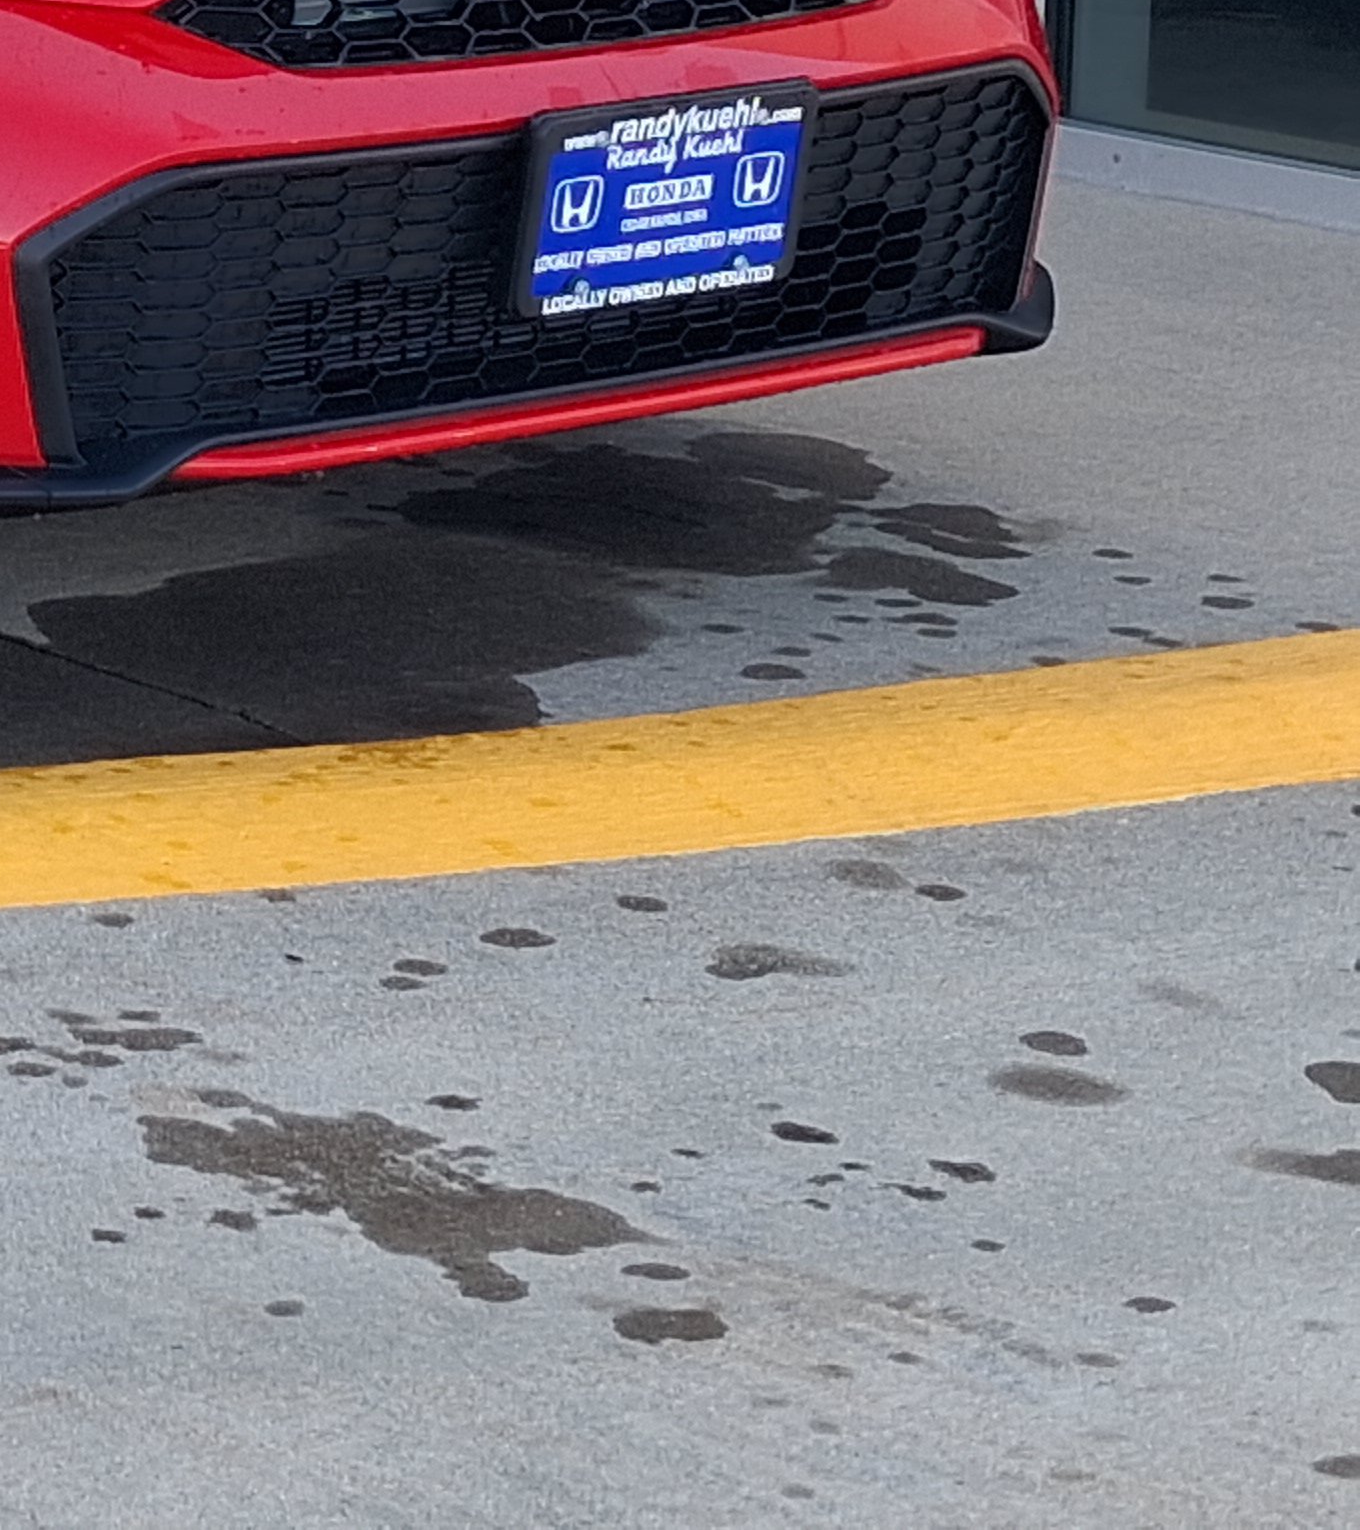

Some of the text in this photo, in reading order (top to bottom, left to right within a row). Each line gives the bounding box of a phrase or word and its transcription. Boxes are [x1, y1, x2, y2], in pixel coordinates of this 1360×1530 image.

[606, 130, 745, 174] Randy Kuehl
[629, 178, 707, 205] HONDA
[541, 264, 776, 316] LOCALLY OWNED AND OPERATED
